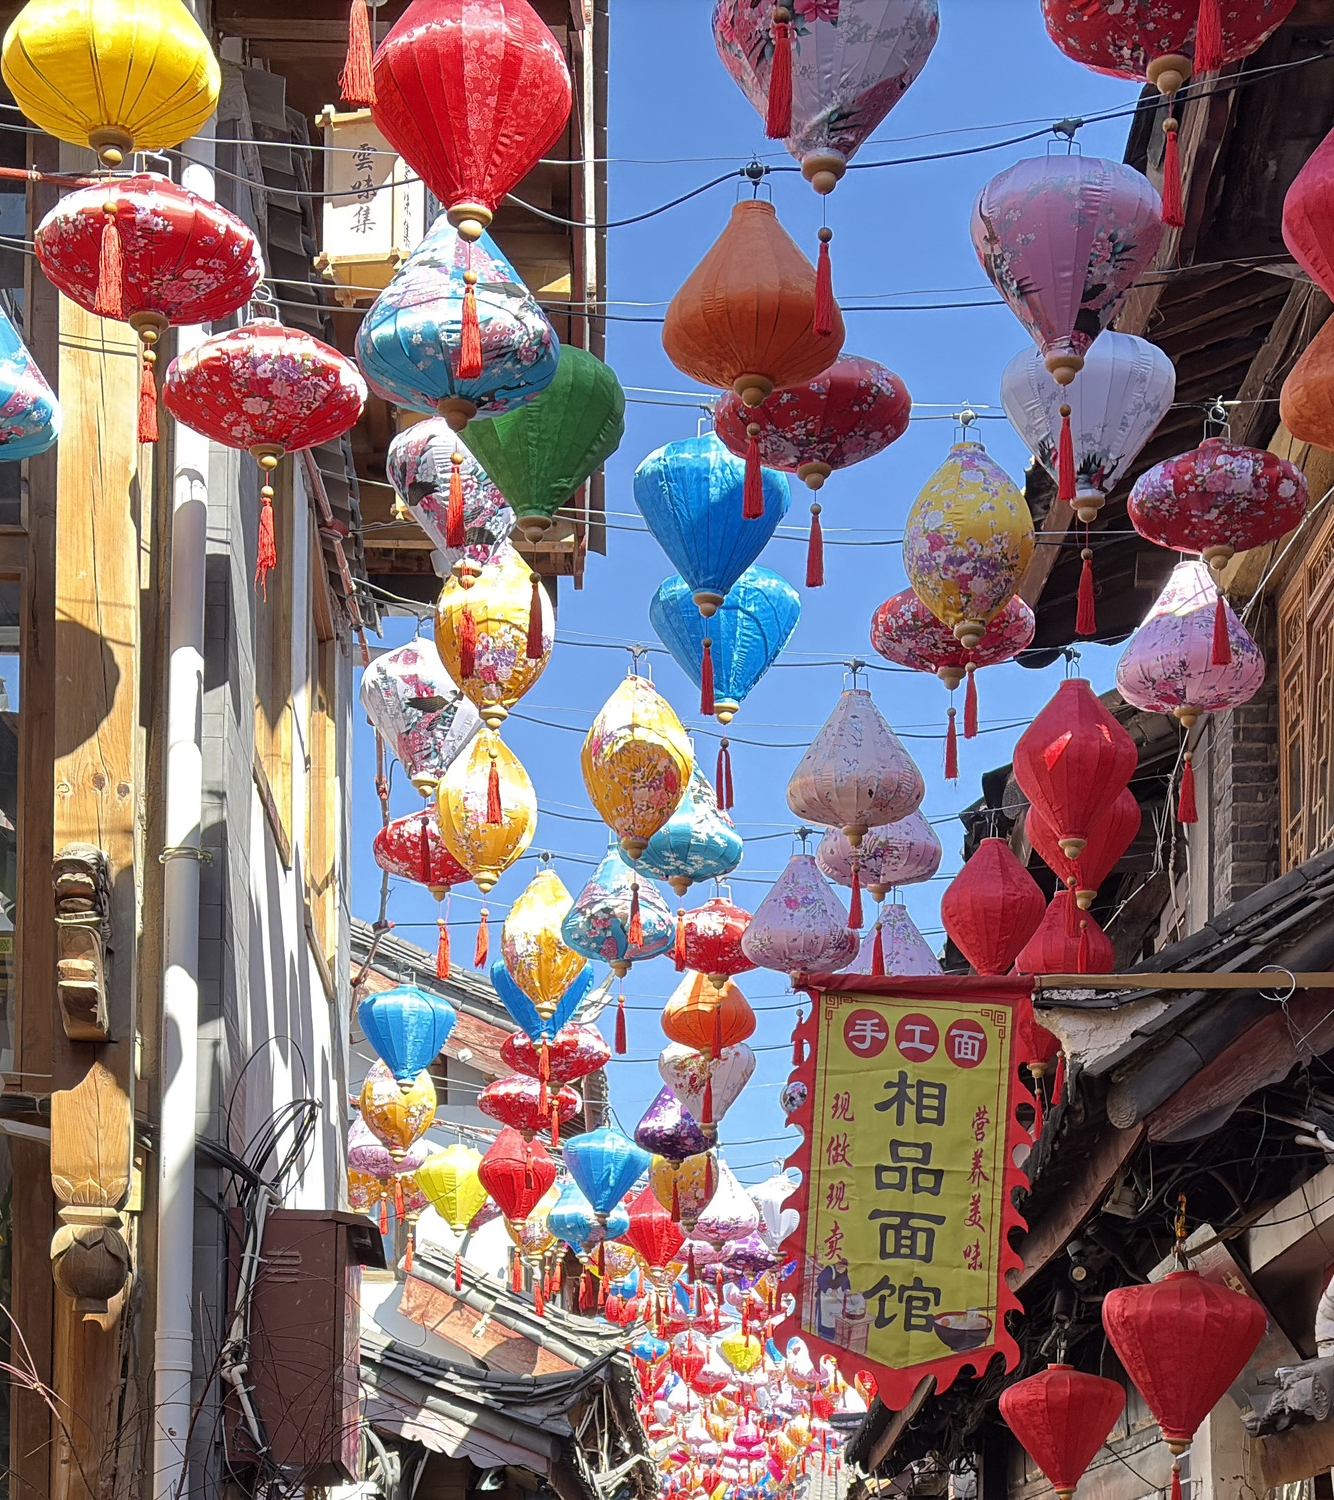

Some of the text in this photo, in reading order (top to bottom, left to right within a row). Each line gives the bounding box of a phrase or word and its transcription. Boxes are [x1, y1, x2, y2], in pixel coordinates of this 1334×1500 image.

[350, 143, 377, 234] 雲味集
[848, 1017, 985, 1062] 手工面
[823, 1092, 855, 1262] 现做现卖
[868, 1070, 947, 1333] 相品面馆
[963, 1106, 991, 1271] 营养美味
